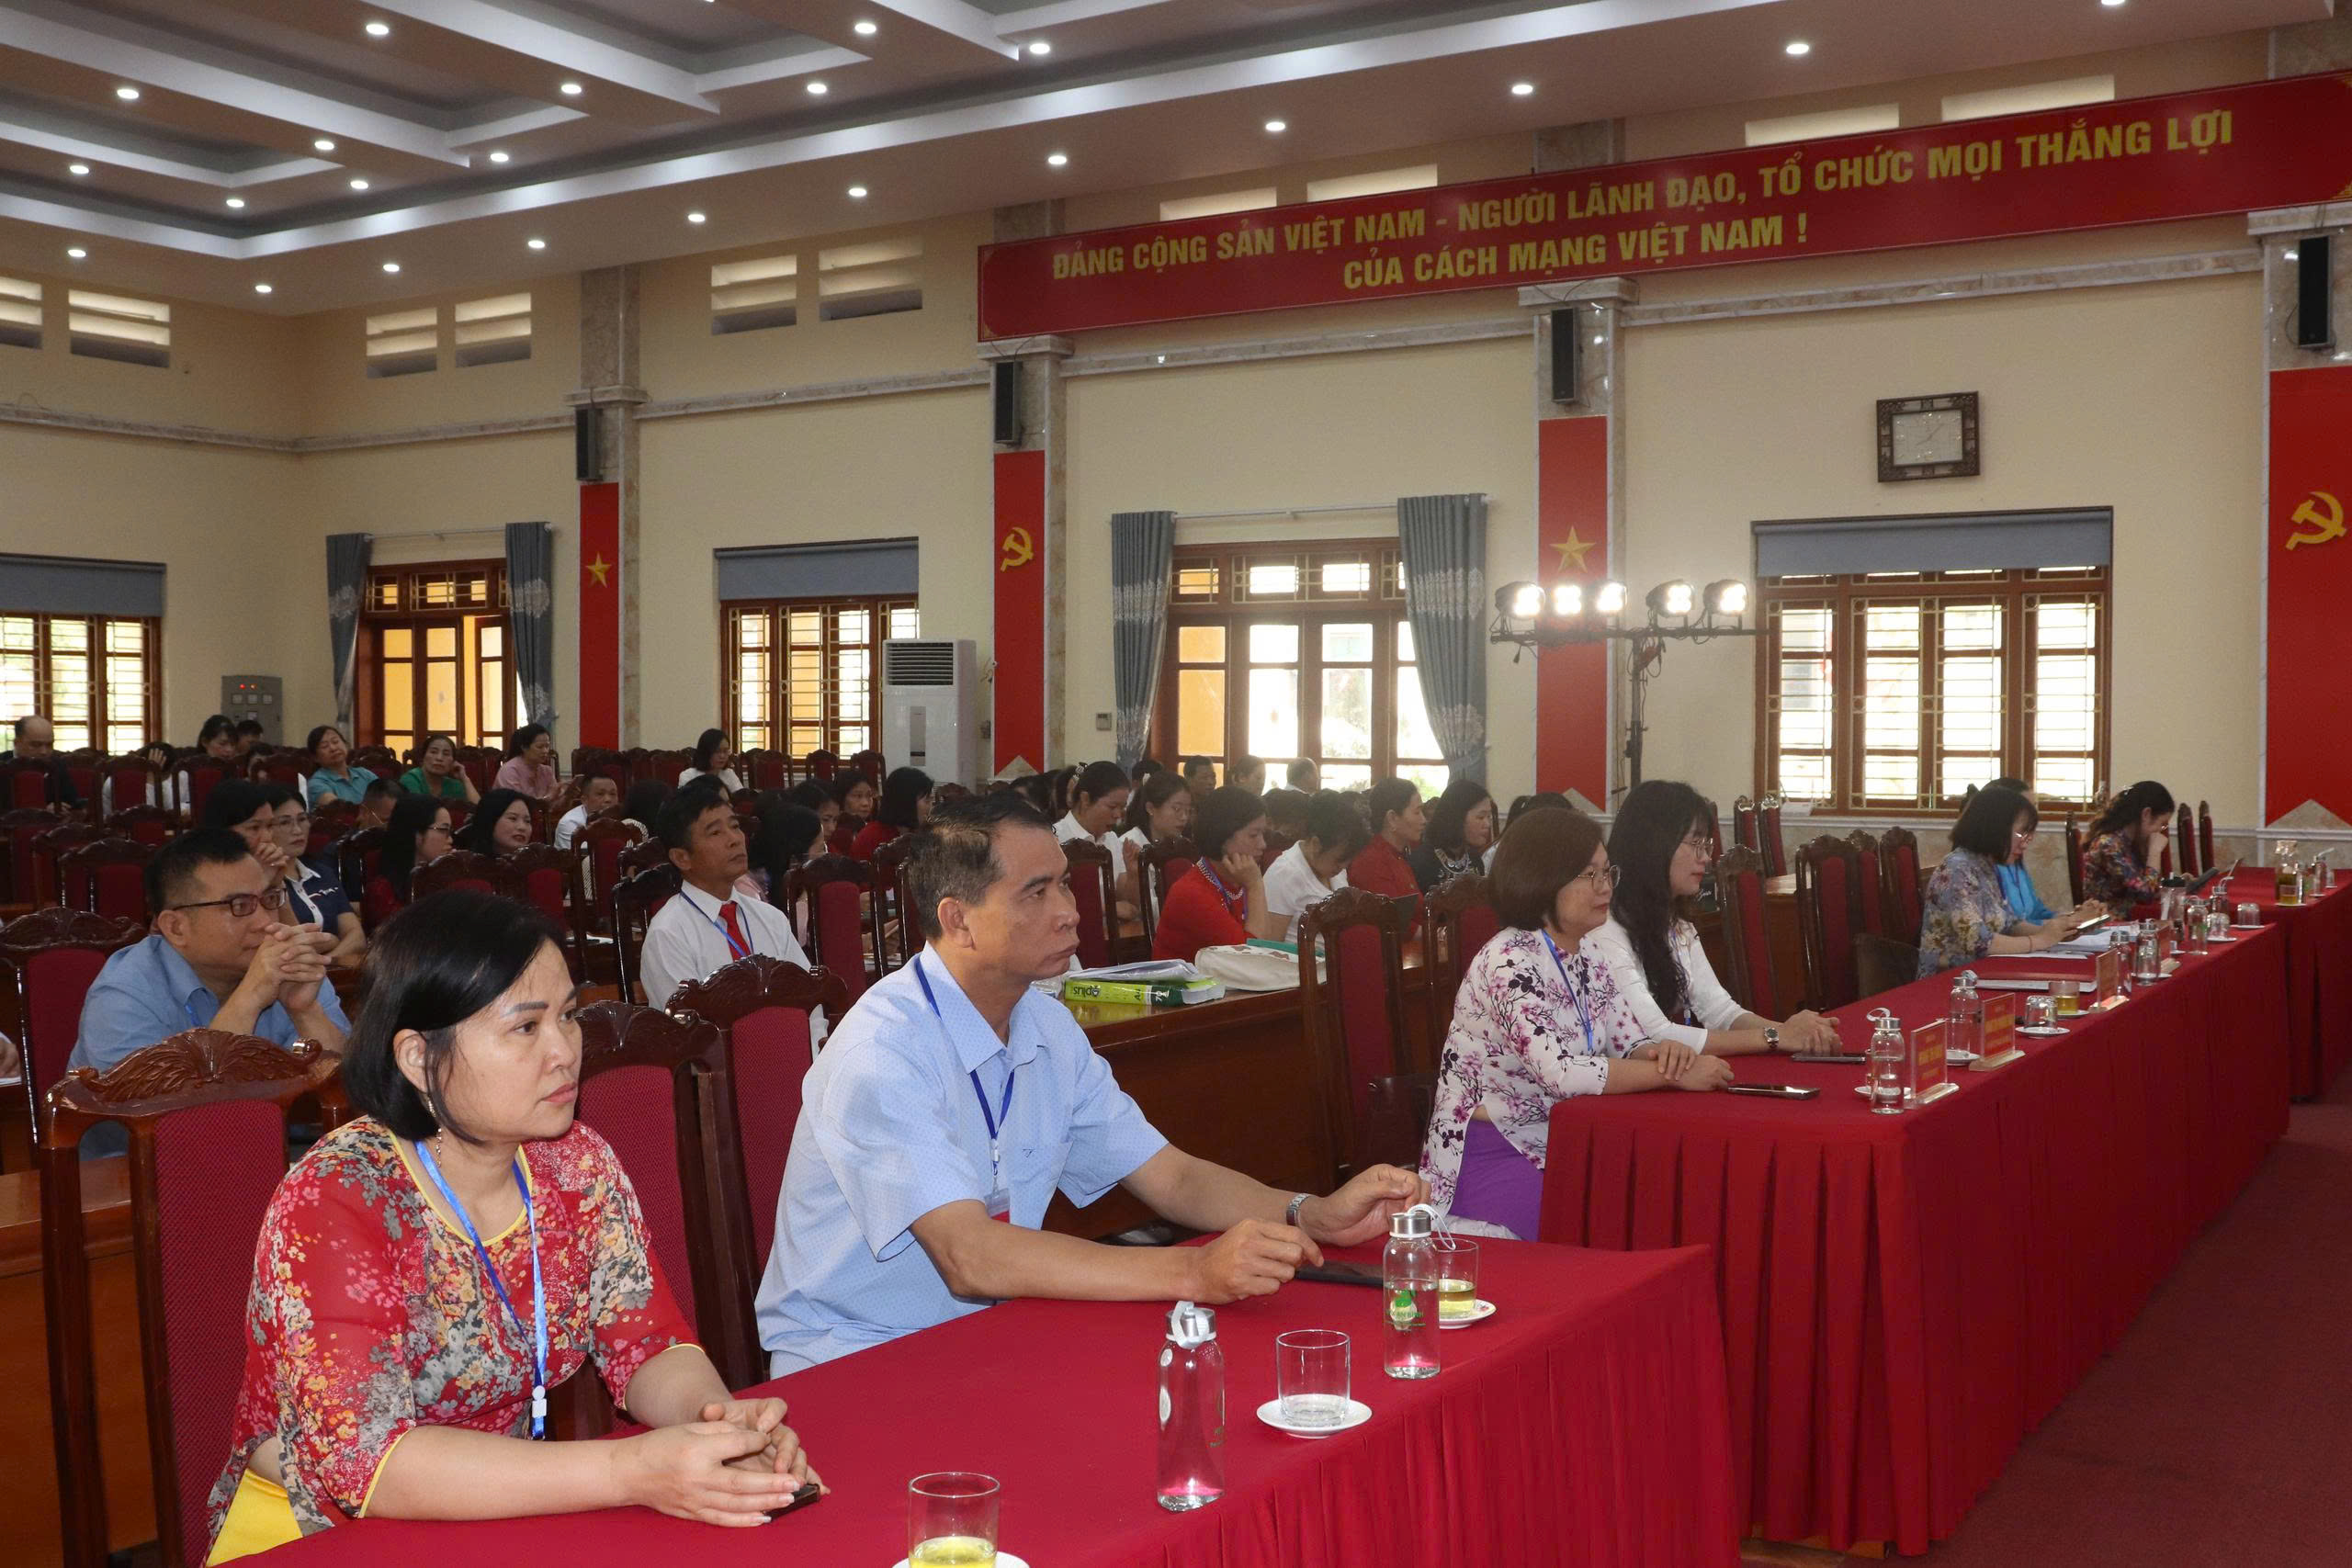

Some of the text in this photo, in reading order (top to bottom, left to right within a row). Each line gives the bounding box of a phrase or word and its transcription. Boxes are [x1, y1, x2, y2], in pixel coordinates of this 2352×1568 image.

[1053, 240, 1125, 279] ĐẢNG
[1133, 235, 1207, 273] CỘNG
[1216, 218, 1275, 260] SẢN
[1284, 215, 1345, 254] VIỆT
[1354, 208, 1425, 243] NAM
[1458, 186, 1556, 231] NGƯỜI
[1567, 181, 1655, 220] LÃNH
[1666, 172, 1747, 212] ĐẠO,
[1758, 151, 1804, 198] TỔ
[1814, 145, 1915, 192] CHỨC
[1928, 140, 2003, 181] MỌI
[2015, 118, 2153, 169] THẮNG
[2166, 108, 2233, 155] LỢI
[1343, 246, 1406, 289] CỦA
[1413, 245, 1498, 282] CÁCH
[1508, 233, 1607, 276] MẠNG
[1617, 221, 1690, 265] VIỆT
[1700, 215, 1783, 254] NAM
